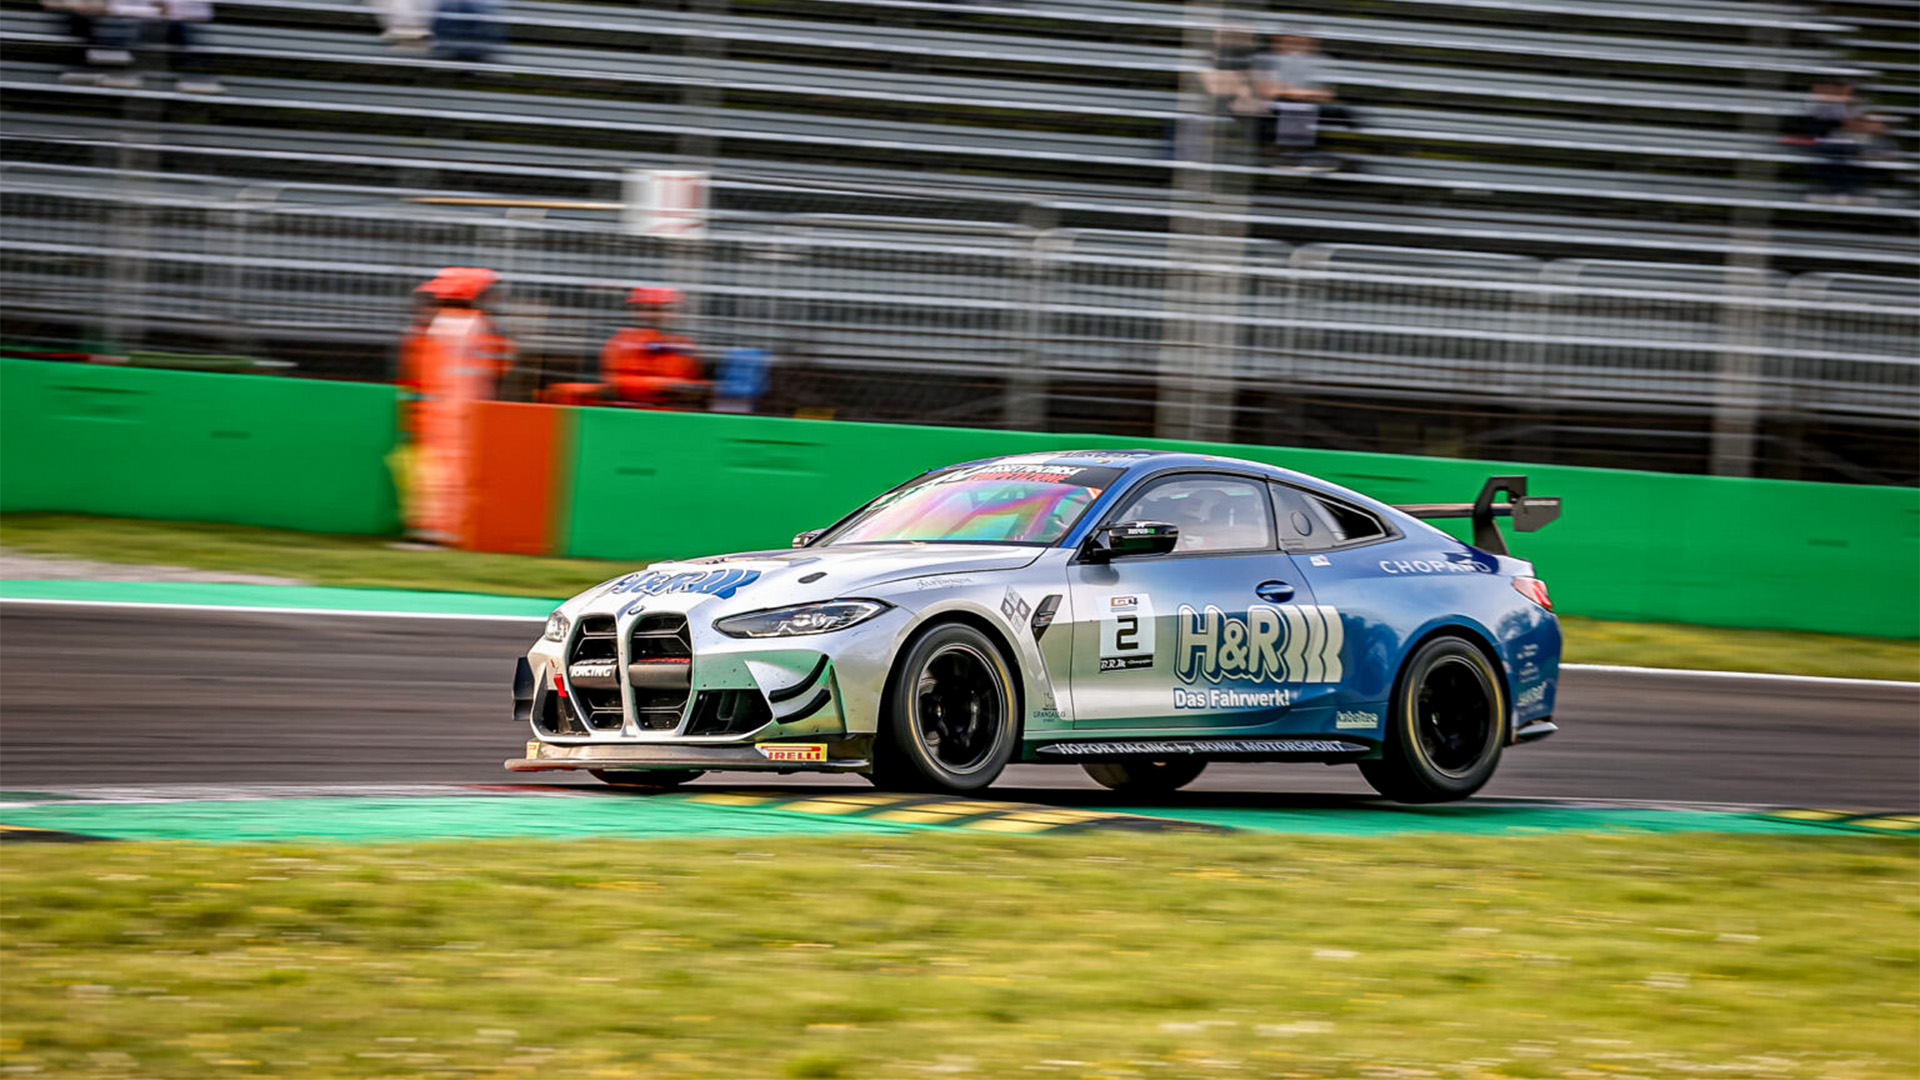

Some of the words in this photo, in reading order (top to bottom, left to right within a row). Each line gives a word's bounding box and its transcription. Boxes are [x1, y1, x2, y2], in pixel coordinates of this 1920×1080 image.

[1116, 615, 1139, 650] 2
[1174, 603, 1290, 684] H&R
[570, 665, 613, 677] RACING
[1174, 689, 1208, 709] Das
[1211, 688, 1291, 707] Fahrwerk!
[1056, 743, 1113, 754] HOFOR
[1115, 742, 1173, 753] RACING
[1242, 740, 1345, 752] MOTORSPORT
